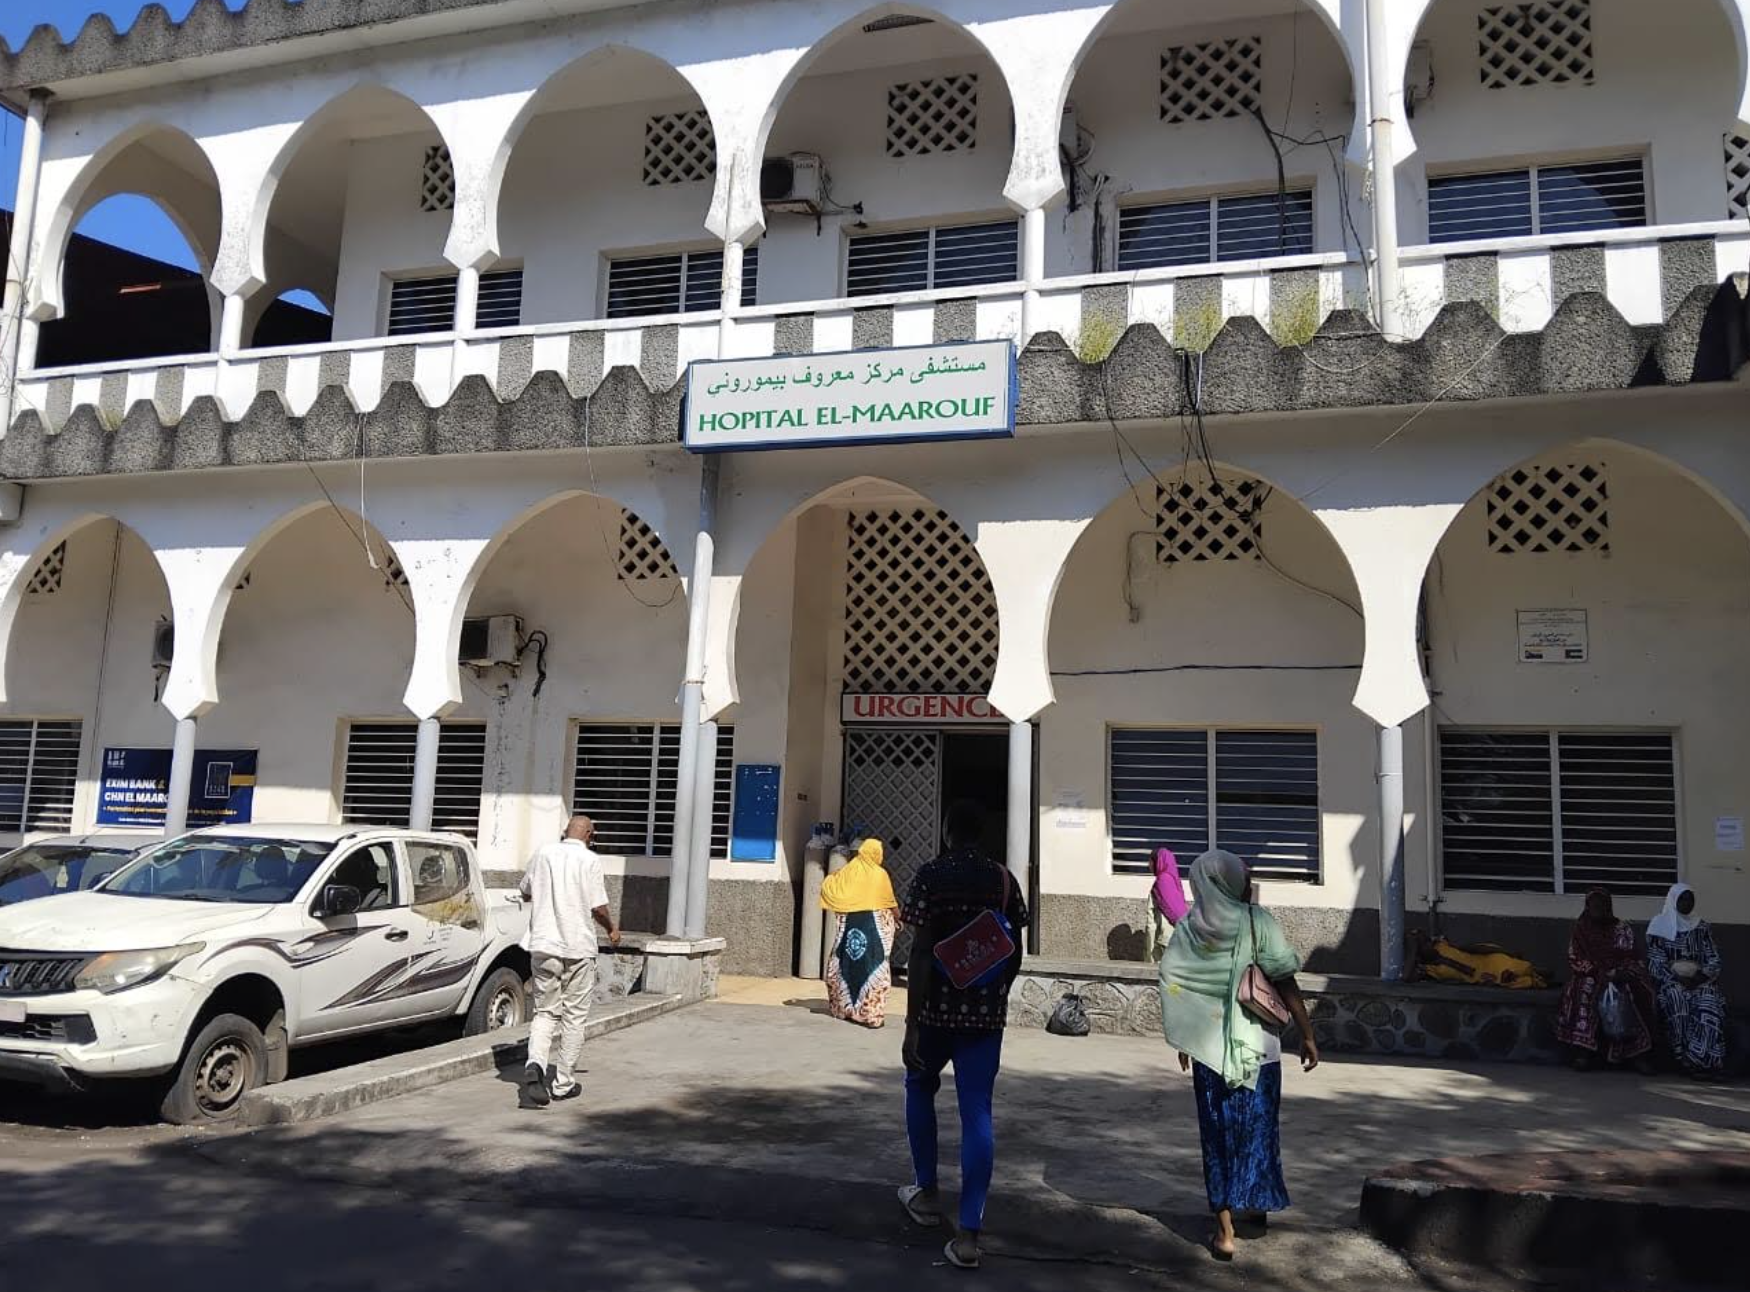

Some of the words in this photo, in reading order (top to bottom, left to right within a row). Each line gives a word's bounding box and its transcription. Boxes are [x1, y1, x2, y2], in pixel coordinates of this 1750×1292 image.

[791, 365, 855, 389] معروف
[861, 362, 904, 385] مركز
[909, 355, 986, 384] مستشفى
[706, 371, 787, 396] بيموروني
[698, 408, 808, 432] HOPITAL
[816, 396, 997, 425] EL-MAAROUF
[853, 695, 1004, 718] URGENC
[105, 778, 128, 788] EXIM
[129, 779, 156, 789] BANK
[104, 792, 124, 801] CHN
[125, 793, 135, 802] EL
